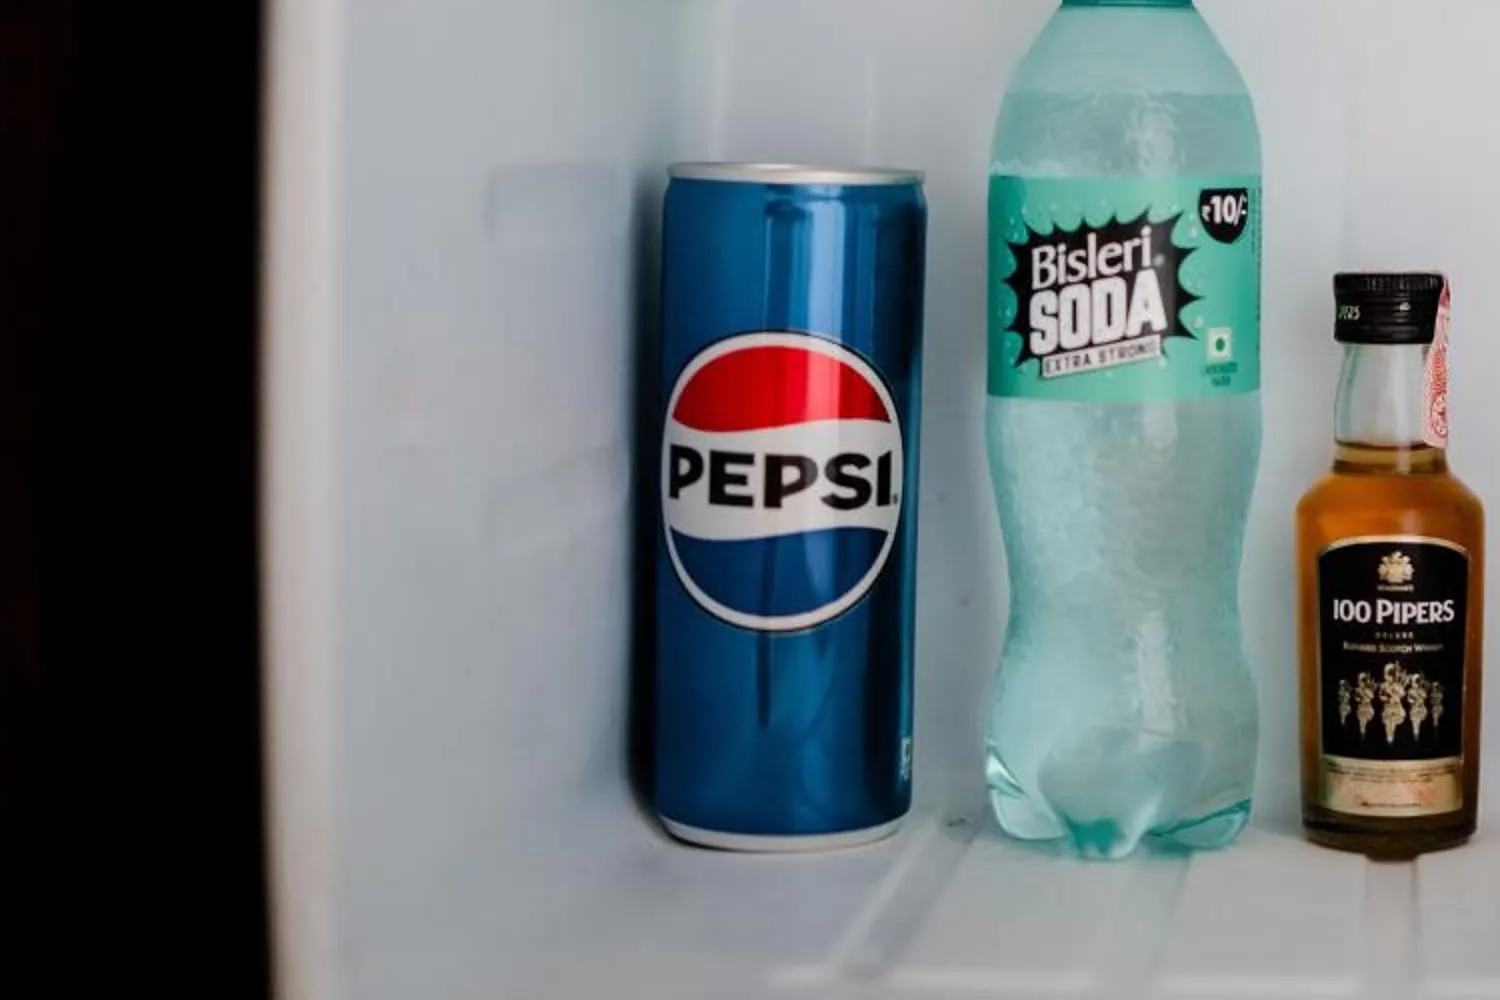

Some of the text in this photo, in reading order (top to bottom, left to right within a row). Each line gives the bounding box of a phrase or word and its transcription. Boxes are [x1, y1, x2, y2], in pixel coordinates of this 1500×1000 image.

[1030, 225, 1153, 291] Bisleri
[1029, 267, 1168, 356] SODA
[1045, 353, 1091, 374] EXTRA
[669, 444, 892, 511] PEPSI
[1333, 598, 1455, 625] 100 PIPERS
